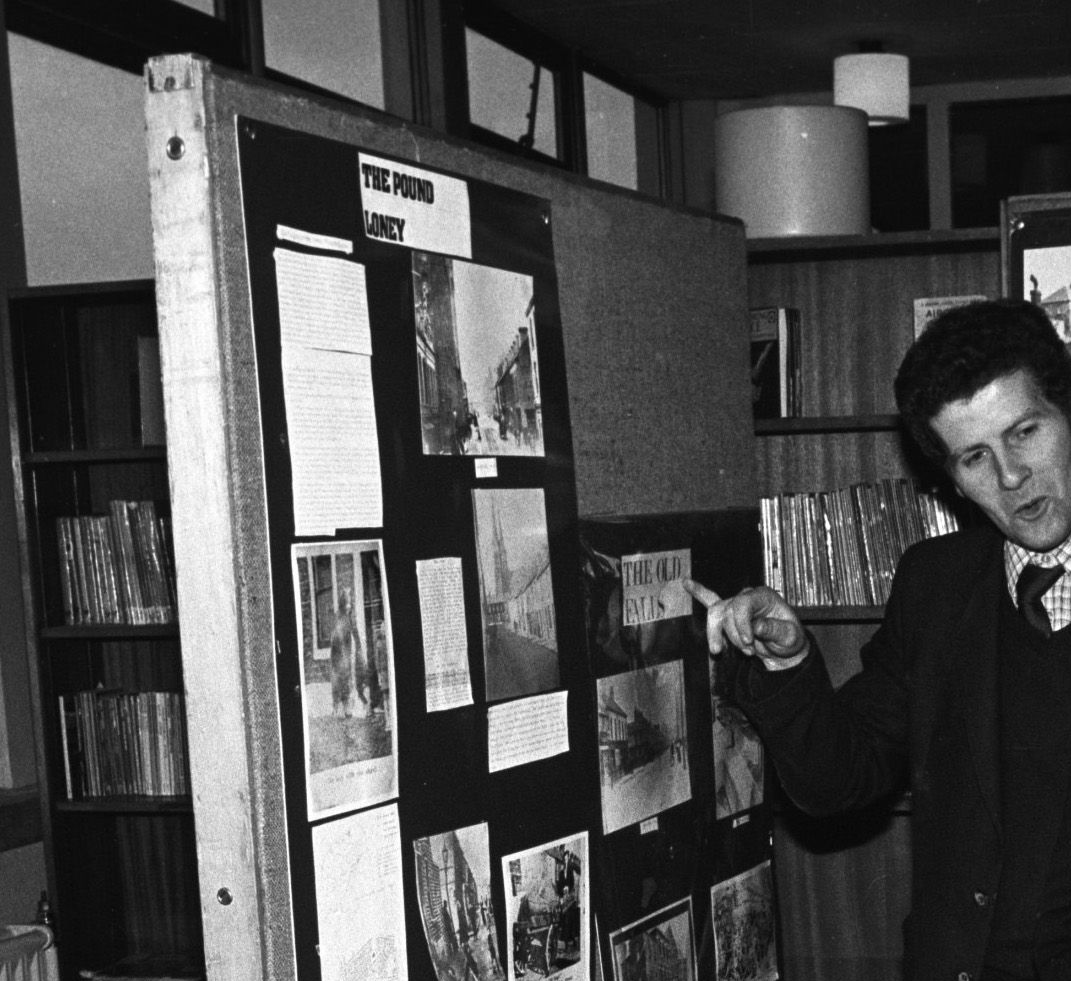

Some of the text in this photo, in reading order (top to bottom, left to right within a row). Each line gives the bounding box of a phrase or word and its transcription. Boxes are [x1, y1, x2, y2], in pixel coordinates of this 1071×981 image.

[361, 163, 435, 205] THE POUND
[364, 210, 406, 243] LONEY
[623, 556, 681, 587] THE OLD
